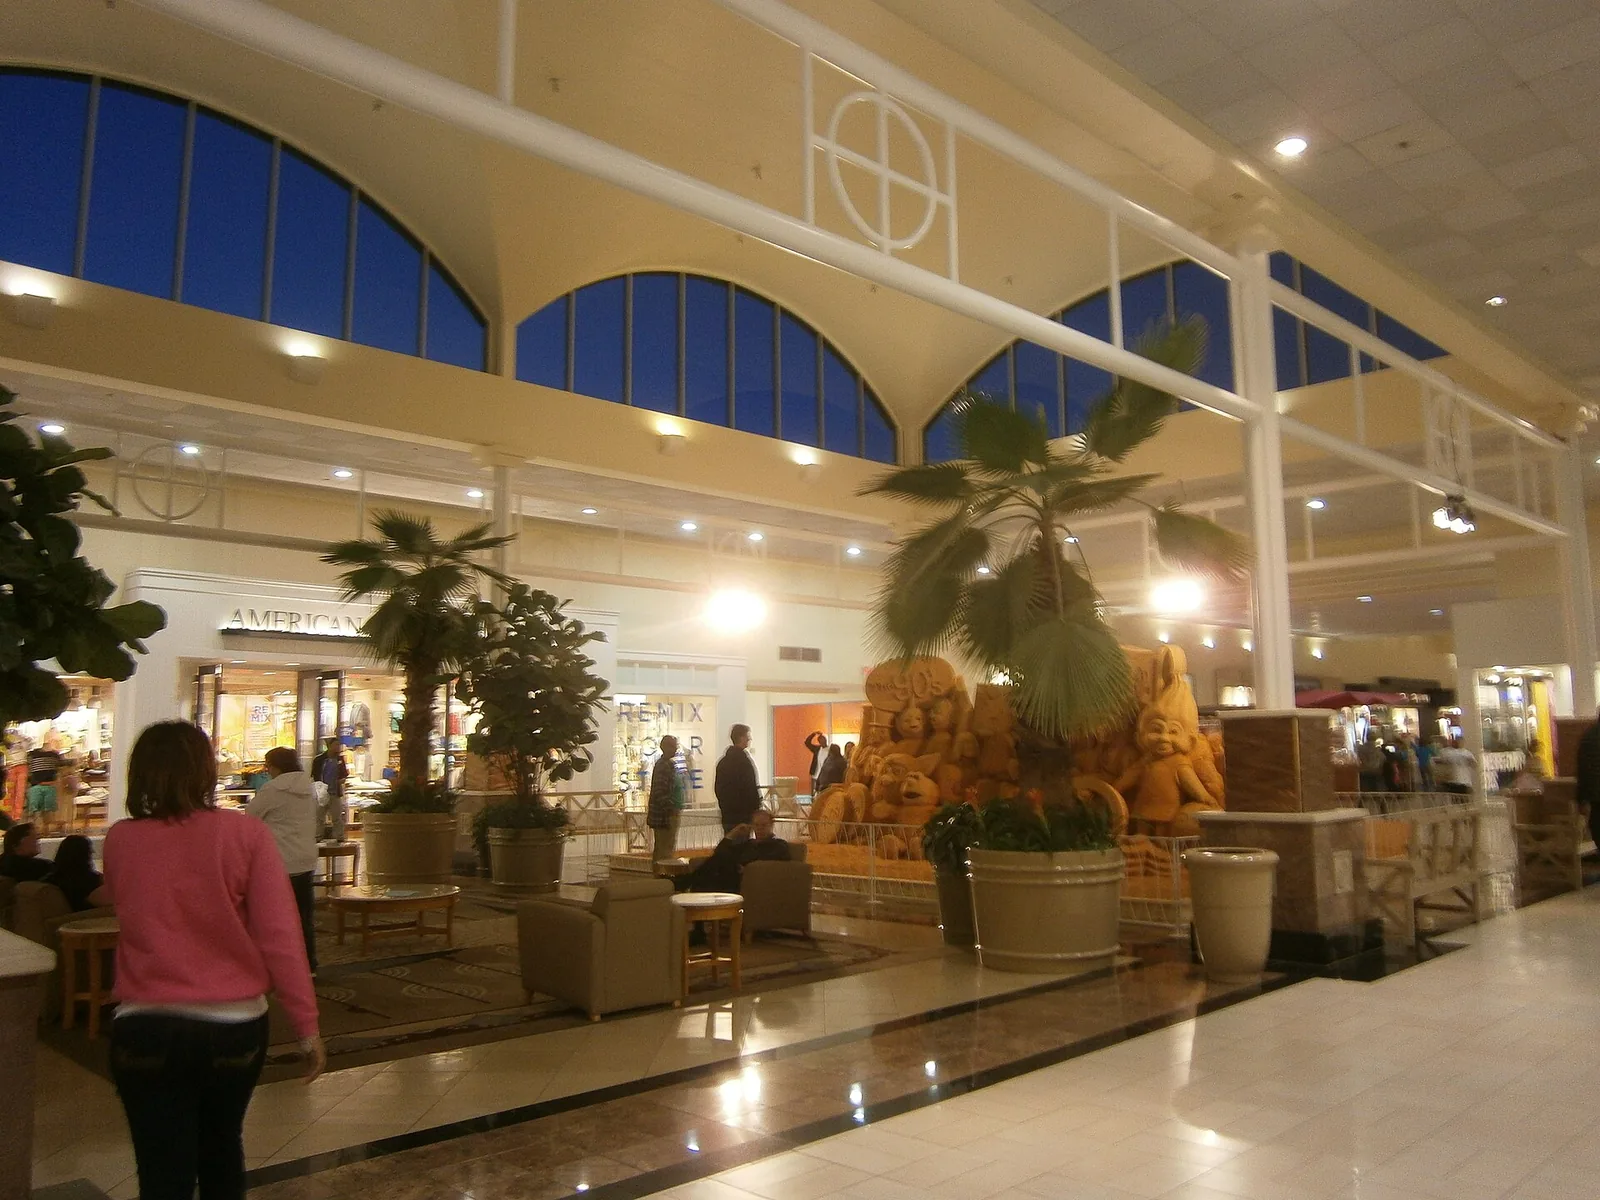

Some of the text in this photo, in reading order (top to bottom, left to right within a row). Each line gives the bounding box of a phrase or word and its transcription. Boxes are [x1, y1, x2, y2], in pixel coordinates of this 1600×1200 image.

[230, 607, 363, 635] AMERICAN
[250, 714, 271, 723] MIX
[253, 704, 269, 715] RE
[617, 702, 704, 723] REMIX
[616, 735, 704, 756] YOR
[618, 770, 704, 792] STE
